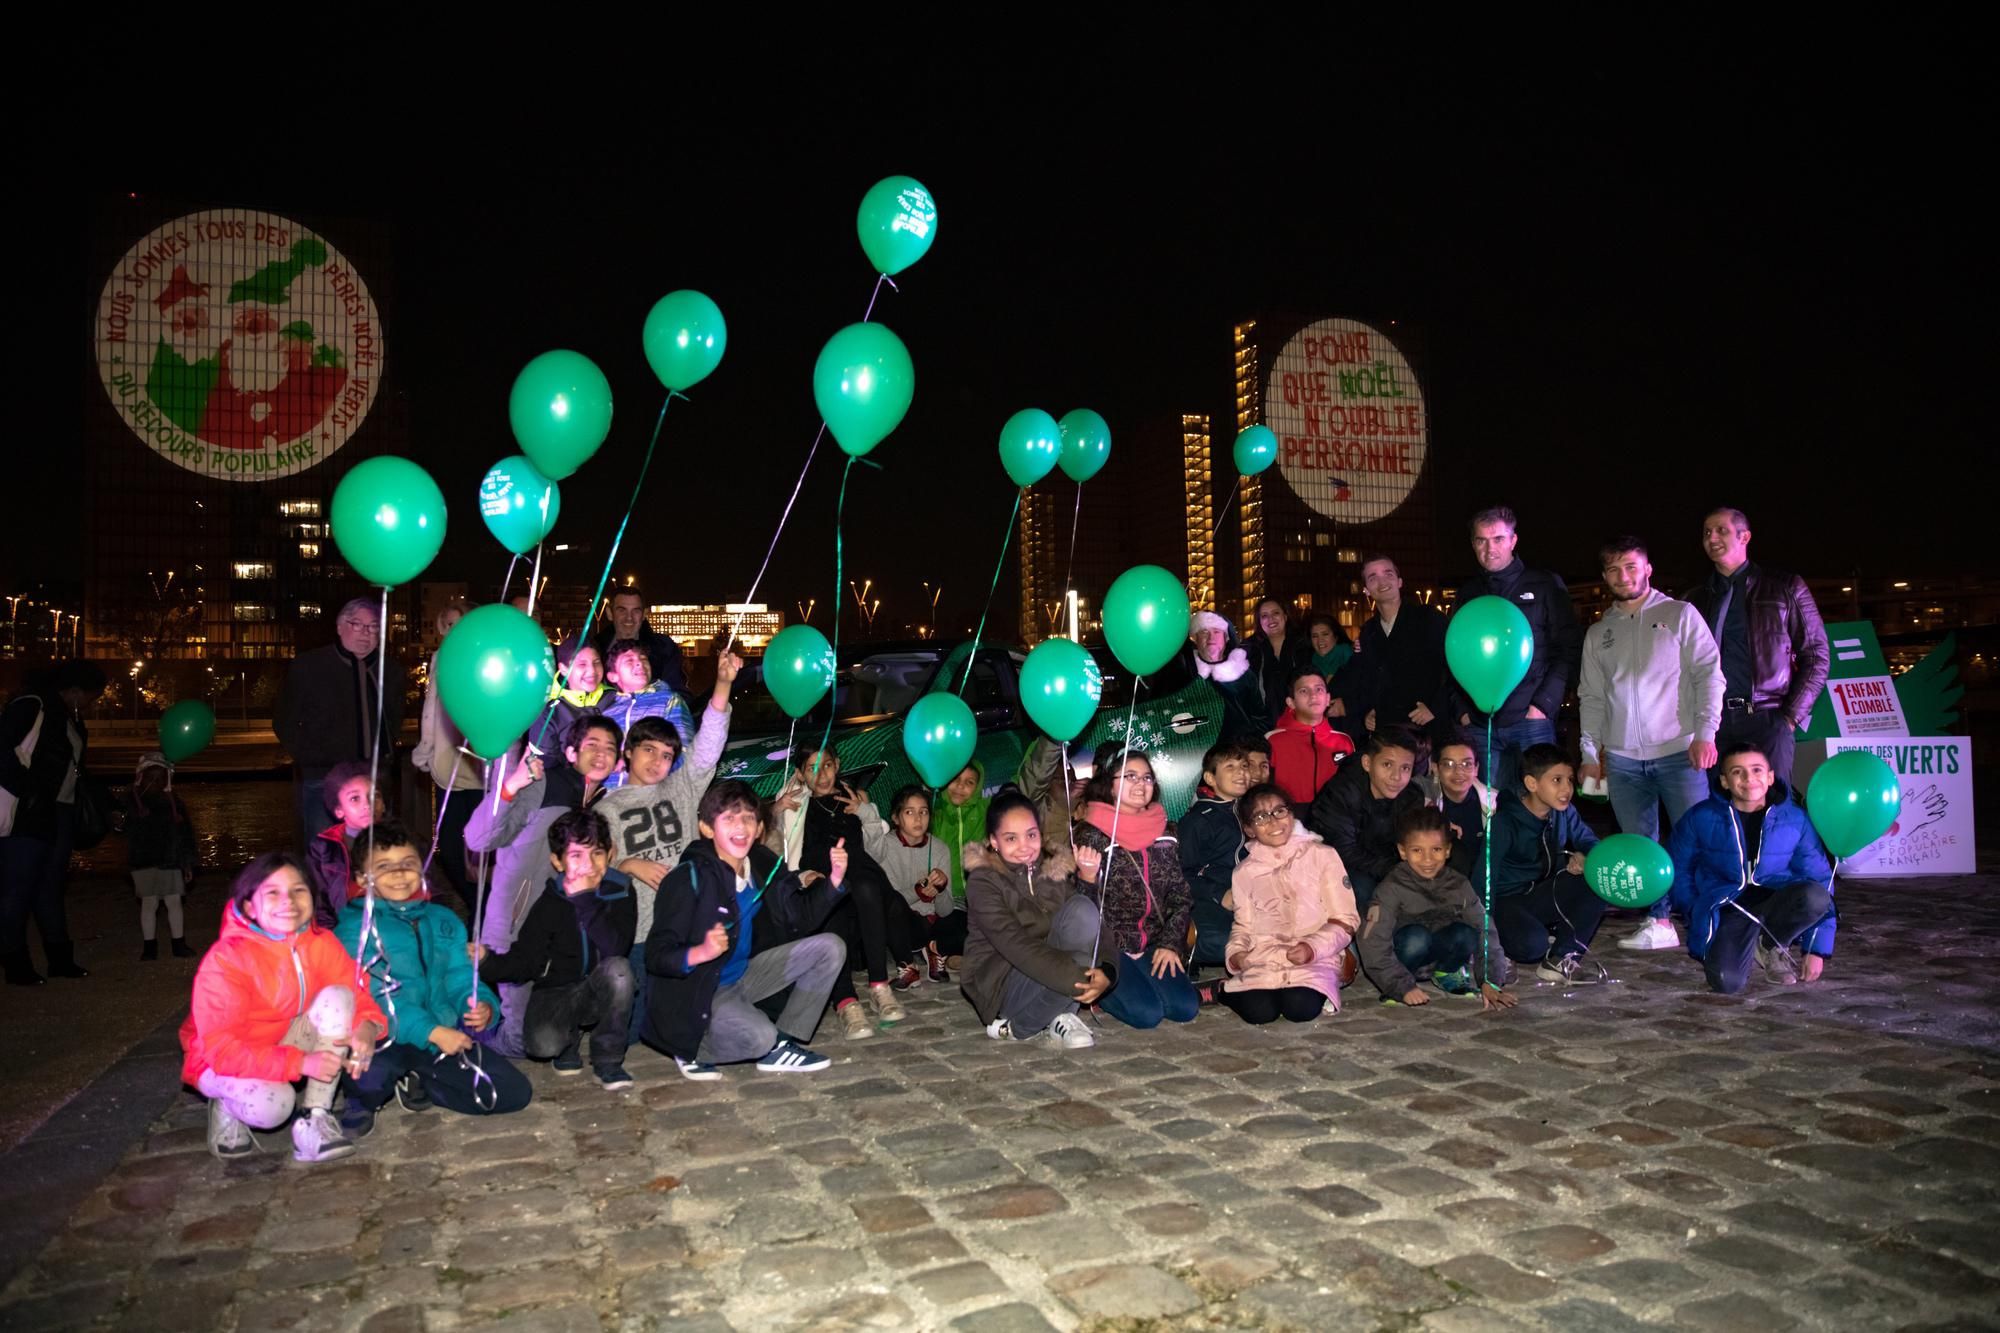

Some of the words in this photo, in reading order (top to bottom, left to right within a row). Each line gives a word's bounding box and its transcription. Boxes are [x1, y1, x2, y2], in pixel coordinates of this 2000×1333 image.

[194, 221, 246, 243] TOUS
[254, 223, 289, 247] DES
[126, 231, 191, 288] SOMMES
[106, 290, 135, 342] NOUS
[353, 322, 378, 368] NOËL
[1304, 331, 1371, 367] POUR
[1283, 371, 1332, 410] QUE
[1338, 360, 1404, 399] NOËL
[111, 371, 139, 397] DU
[129, 399, 206, 464] SECOURS
[211, 438, 318, 472] POPULAIRE
[332, 378, 369, 429] VERTS
[1284, 437, 1412, 474] PERSONNE
[1833, 684, 1851, 715] 1
[1845, 681, 1888, 698] ENFANT
[1850, 695, 1895, 715] COMBLÉ
[1876, 745, 1893, 758] DES
[1894, 744, 1959, 774] VERTS
[620, 800, 683, 856] 28
[1889, 835, 1957, 856] POPULAIRE
[1878, 849, 1941, 867] FRANÇAIS
